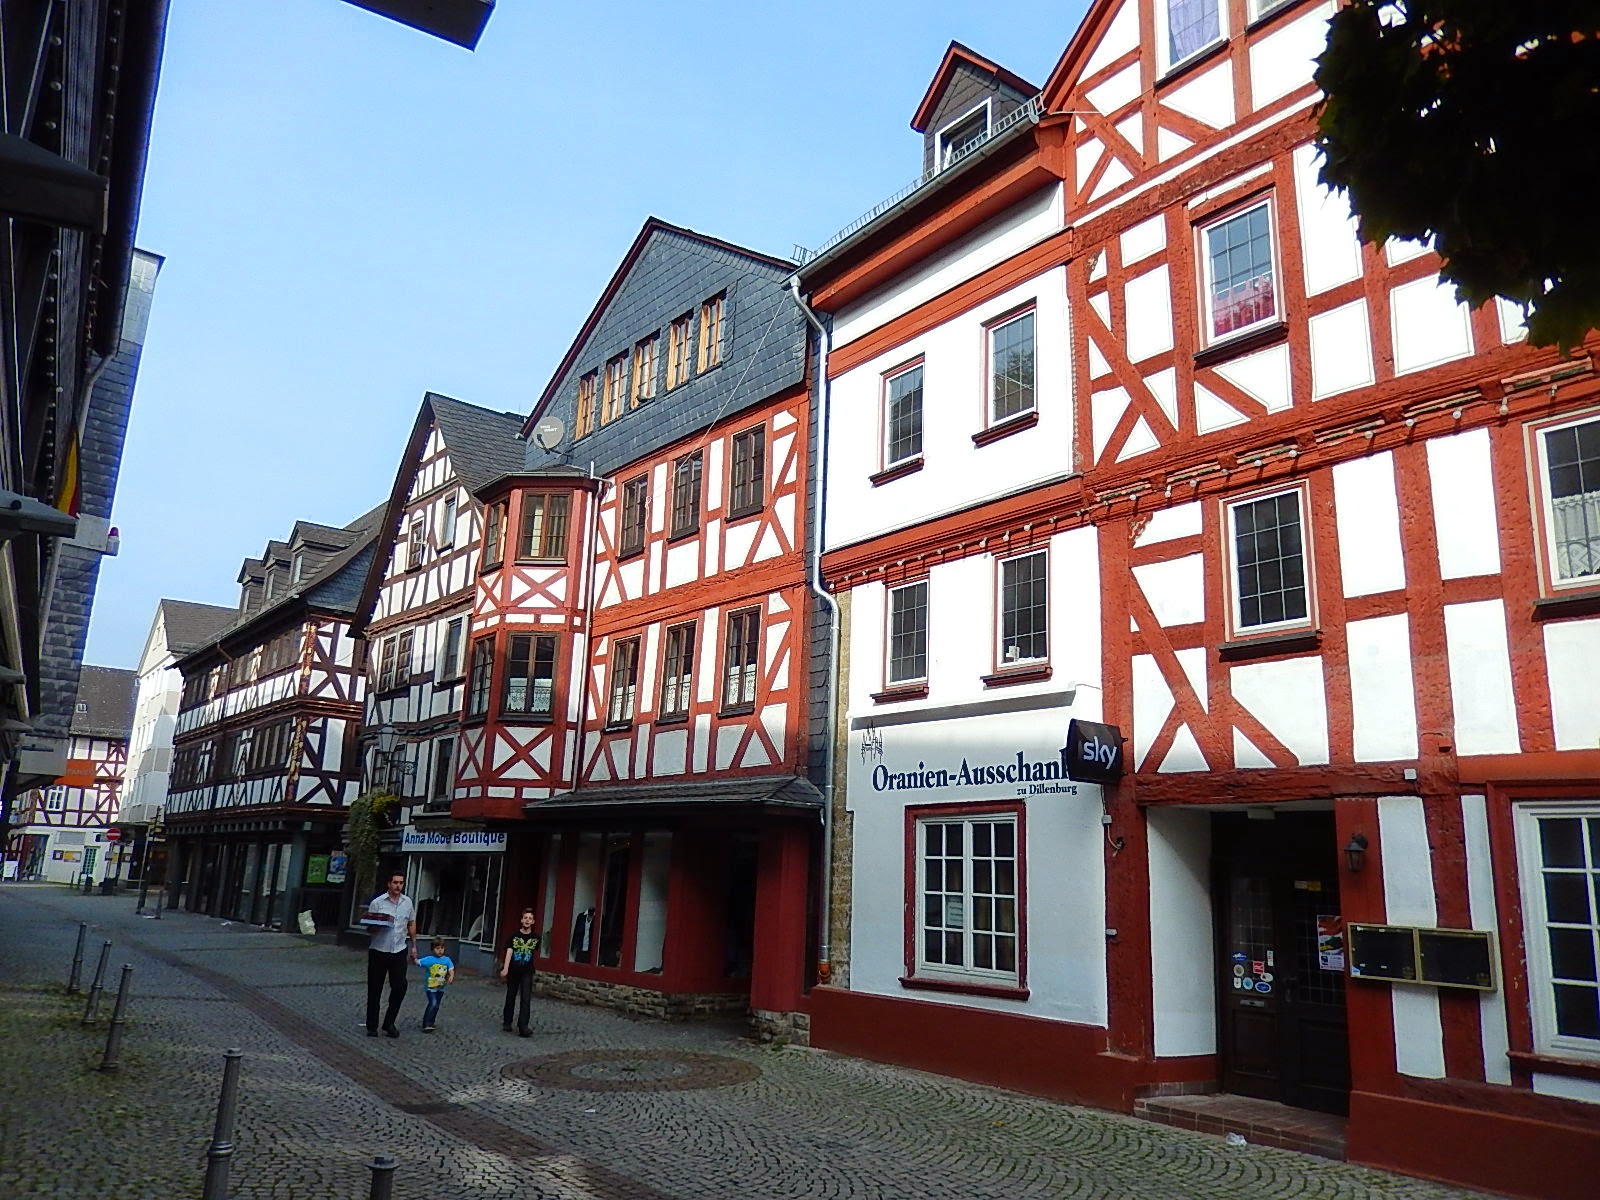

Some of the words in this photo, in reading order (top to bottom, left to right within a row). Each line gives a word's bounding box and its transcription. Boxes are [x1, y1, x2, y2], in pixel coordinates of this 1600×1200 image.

[1083, 736, 1118, 770] sky
[1017, 787, 1027, 796] zu
[1029, 783, 1077, 796] Dillenburg
[404, 833, 425, 844] Anna
